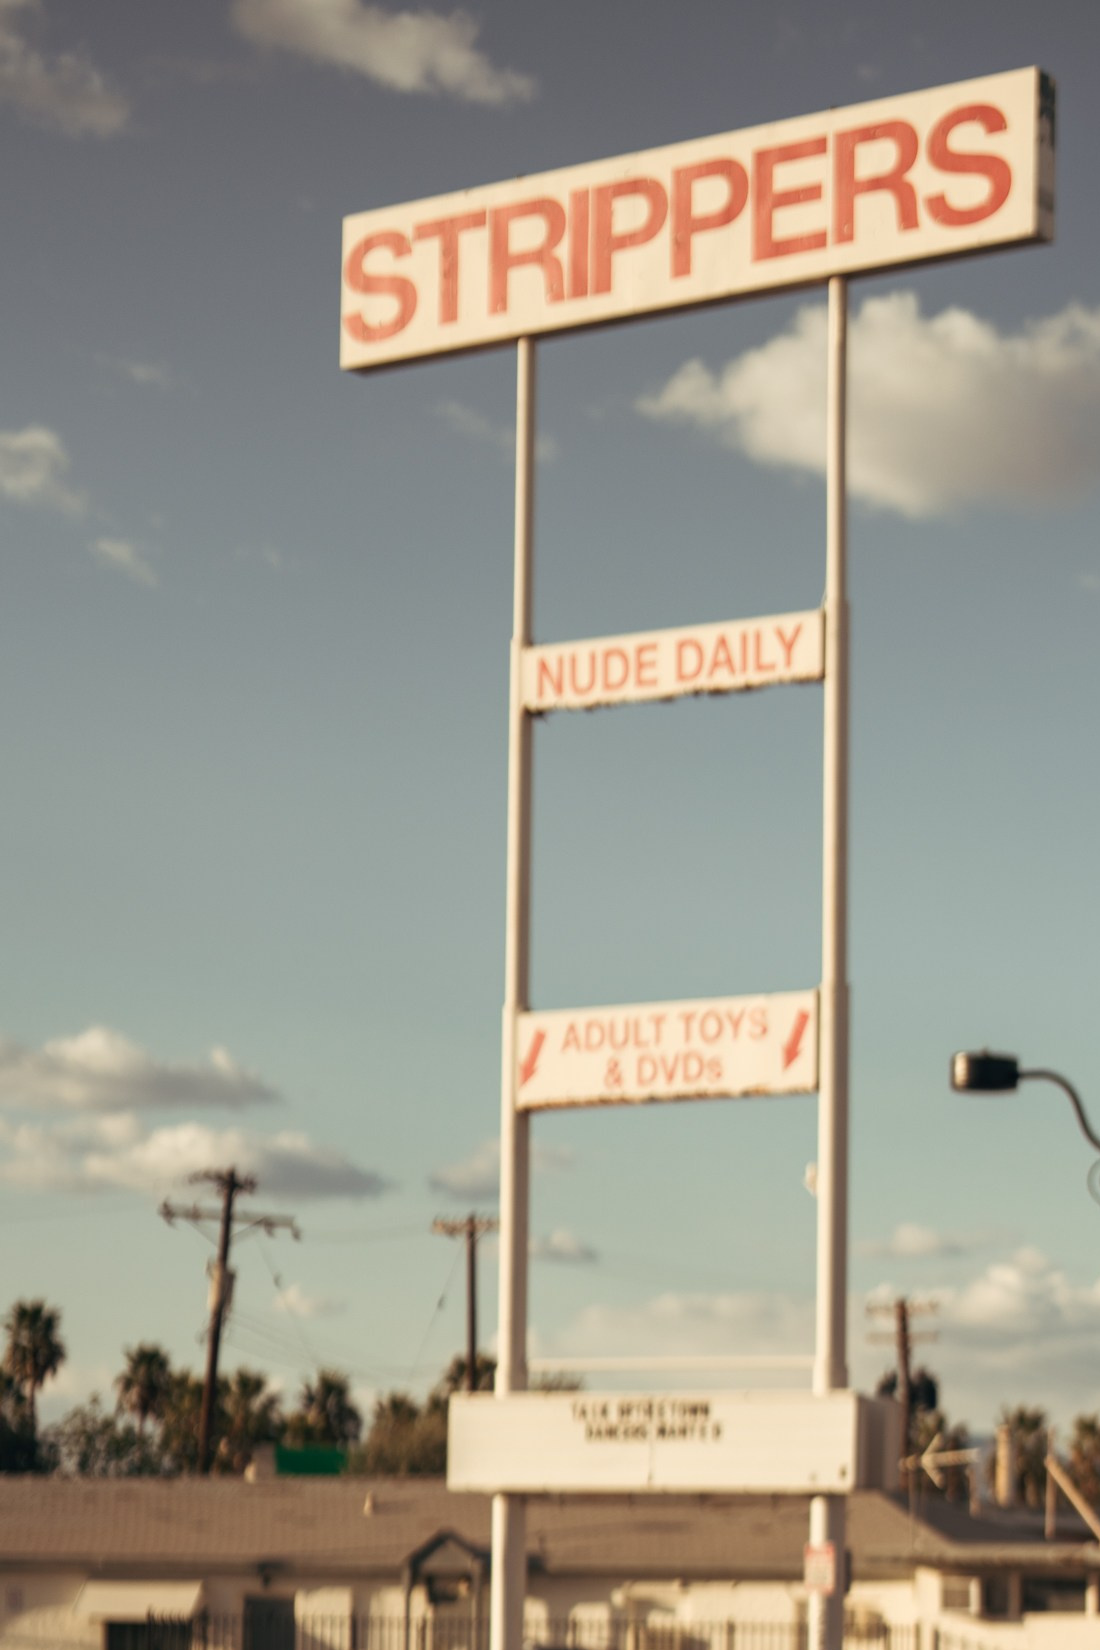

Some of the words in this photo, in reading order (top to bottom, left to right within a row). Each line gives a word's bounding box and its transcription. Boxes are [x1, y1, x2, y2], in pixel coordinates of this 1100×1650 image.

[342, 103, 1013, 345] STRIPPERS
[536, 641, 660, 700] NUDE
[675, 621, 803, 683] DAILY
[561, 1013, 668, 1054] ADULT
[678, 1006, 769, 1045] TOYS
[603, 1056, 623, 1090] &
